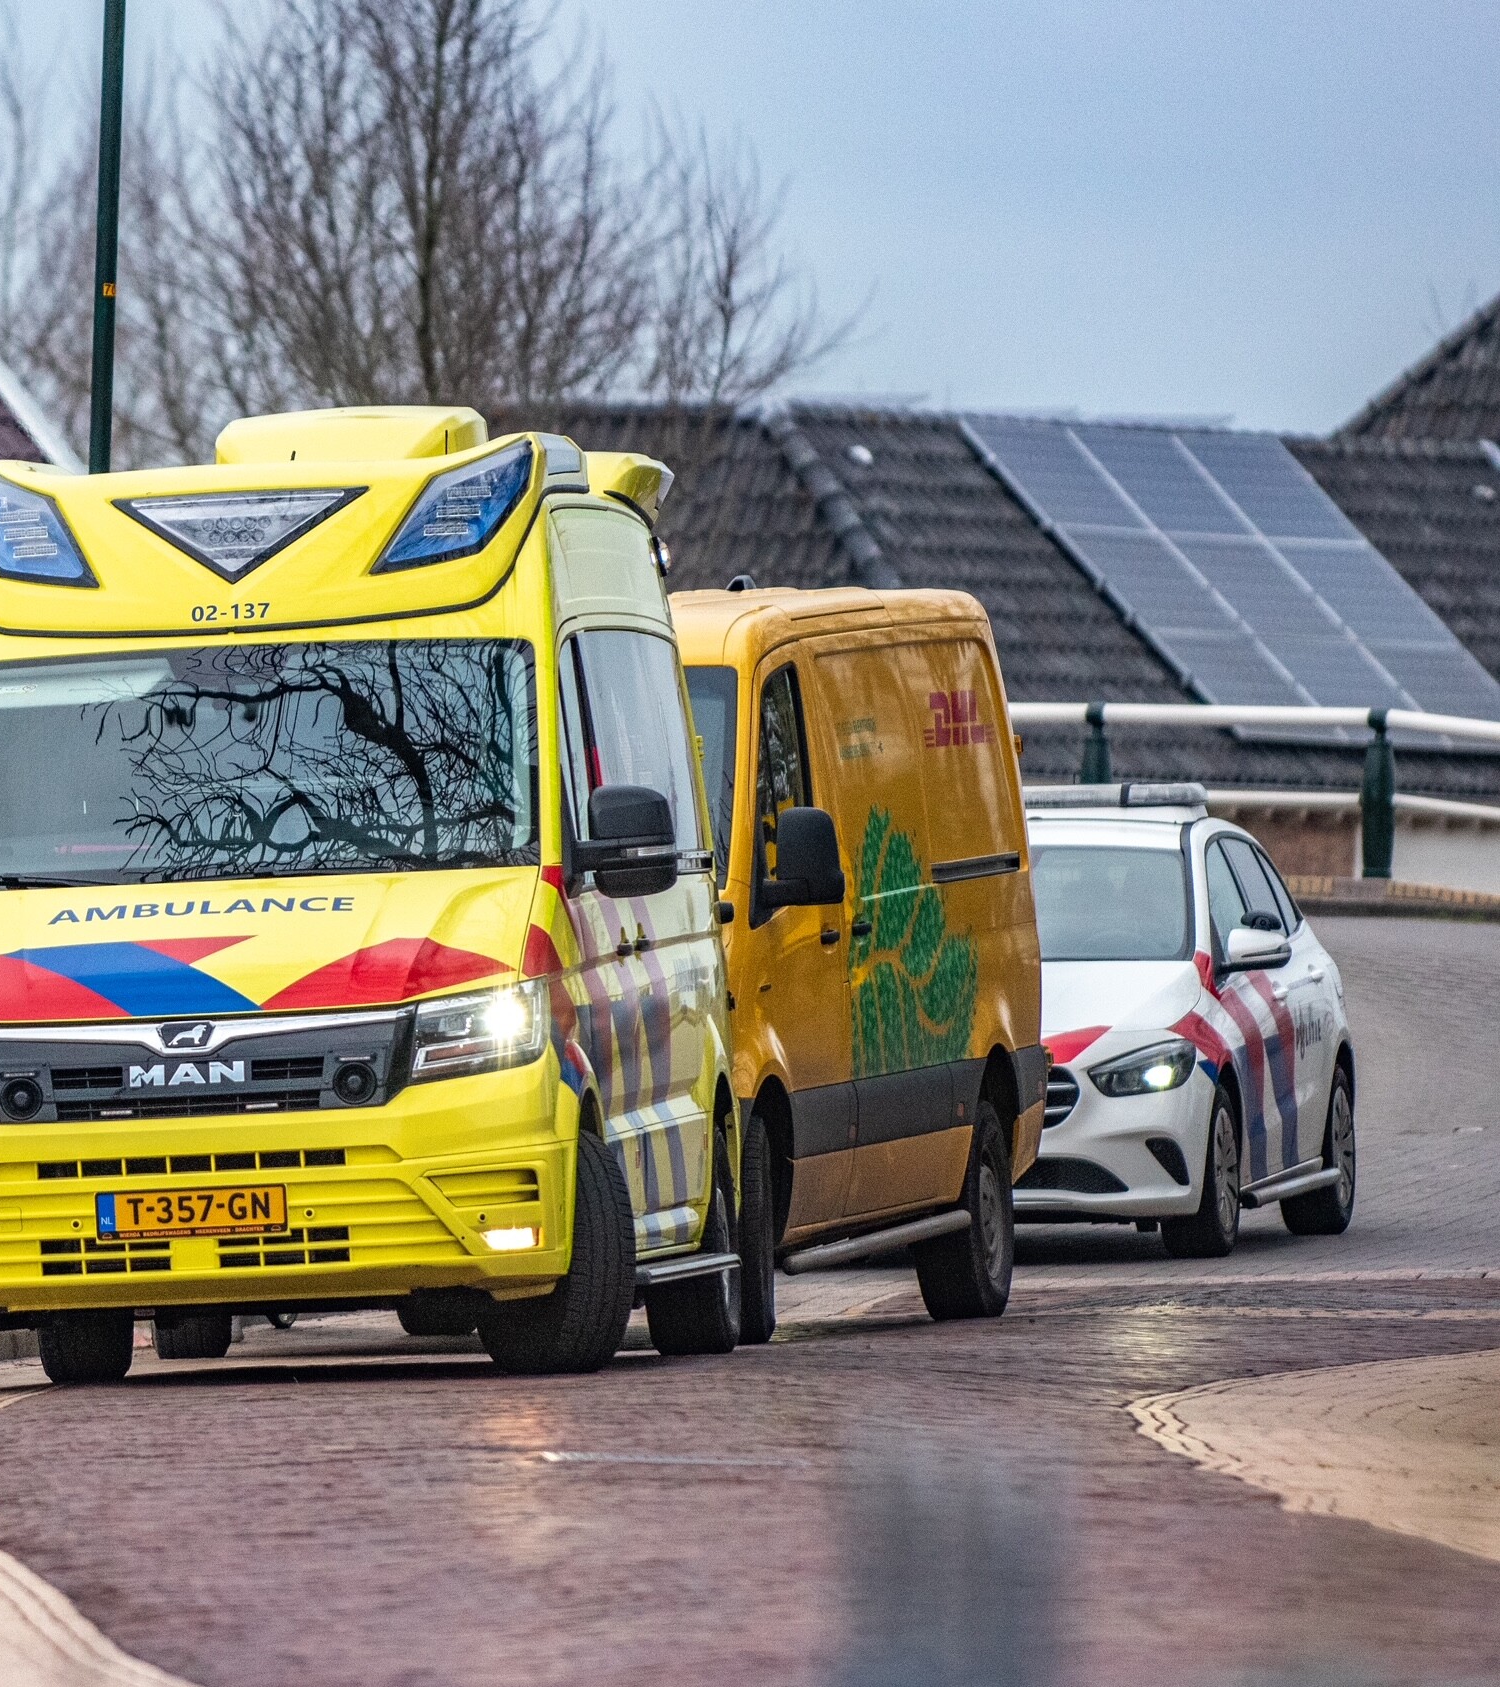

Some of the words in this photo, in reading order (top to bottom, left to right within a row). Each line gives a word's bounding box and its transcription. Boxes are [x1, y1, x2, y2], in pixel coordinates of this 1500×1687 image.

[191, 603, 270, 622] 02-137
[928, 690, 987, 748] DHL
[47, 897, 355, 925] AMBULANCE
[129, 1060, 245, 1088] MAN
[101, 1217, 113, 1225] NL
[126, 1191, 271, 1225] T-357-GN
